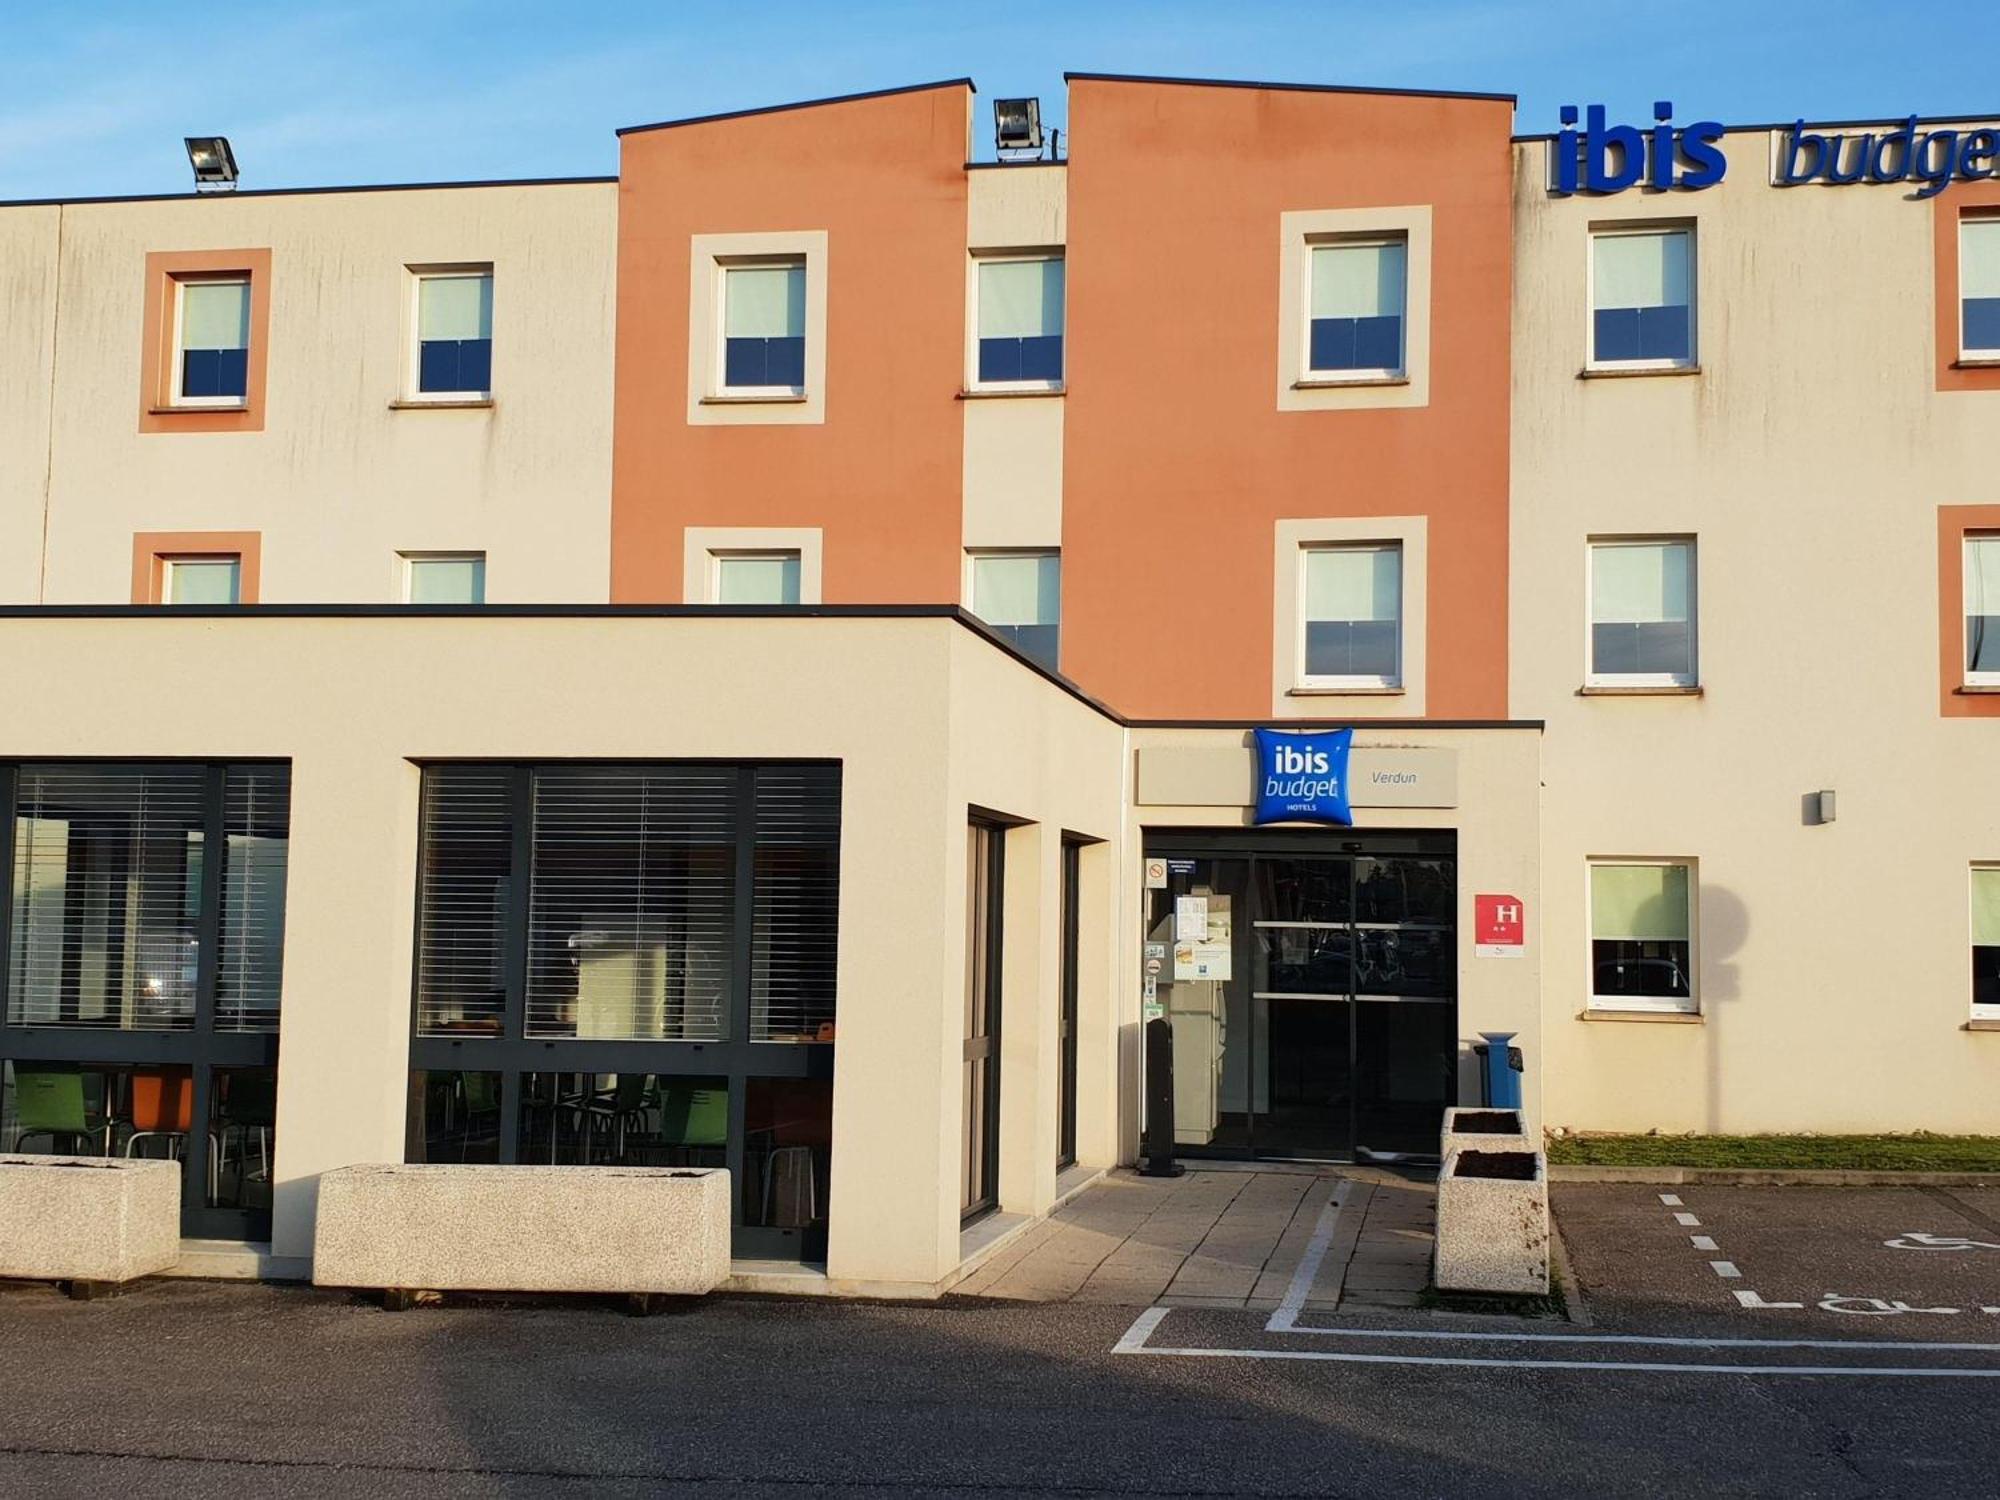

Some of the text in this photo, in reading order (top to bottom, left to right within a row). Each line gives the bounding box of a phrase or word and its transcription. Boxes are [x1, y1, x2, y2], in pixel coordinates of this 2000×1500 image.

[1559, 101, 2000, 198] ibis budge
[1275, 746, 1329, 774] ibis
[1265, 776, 1339, 801] budget
[1372, 772, 1417, 784] Verdun
[1286, 804, 1317, 812] HOTELS
[1496, 904, 1520, 923] H
